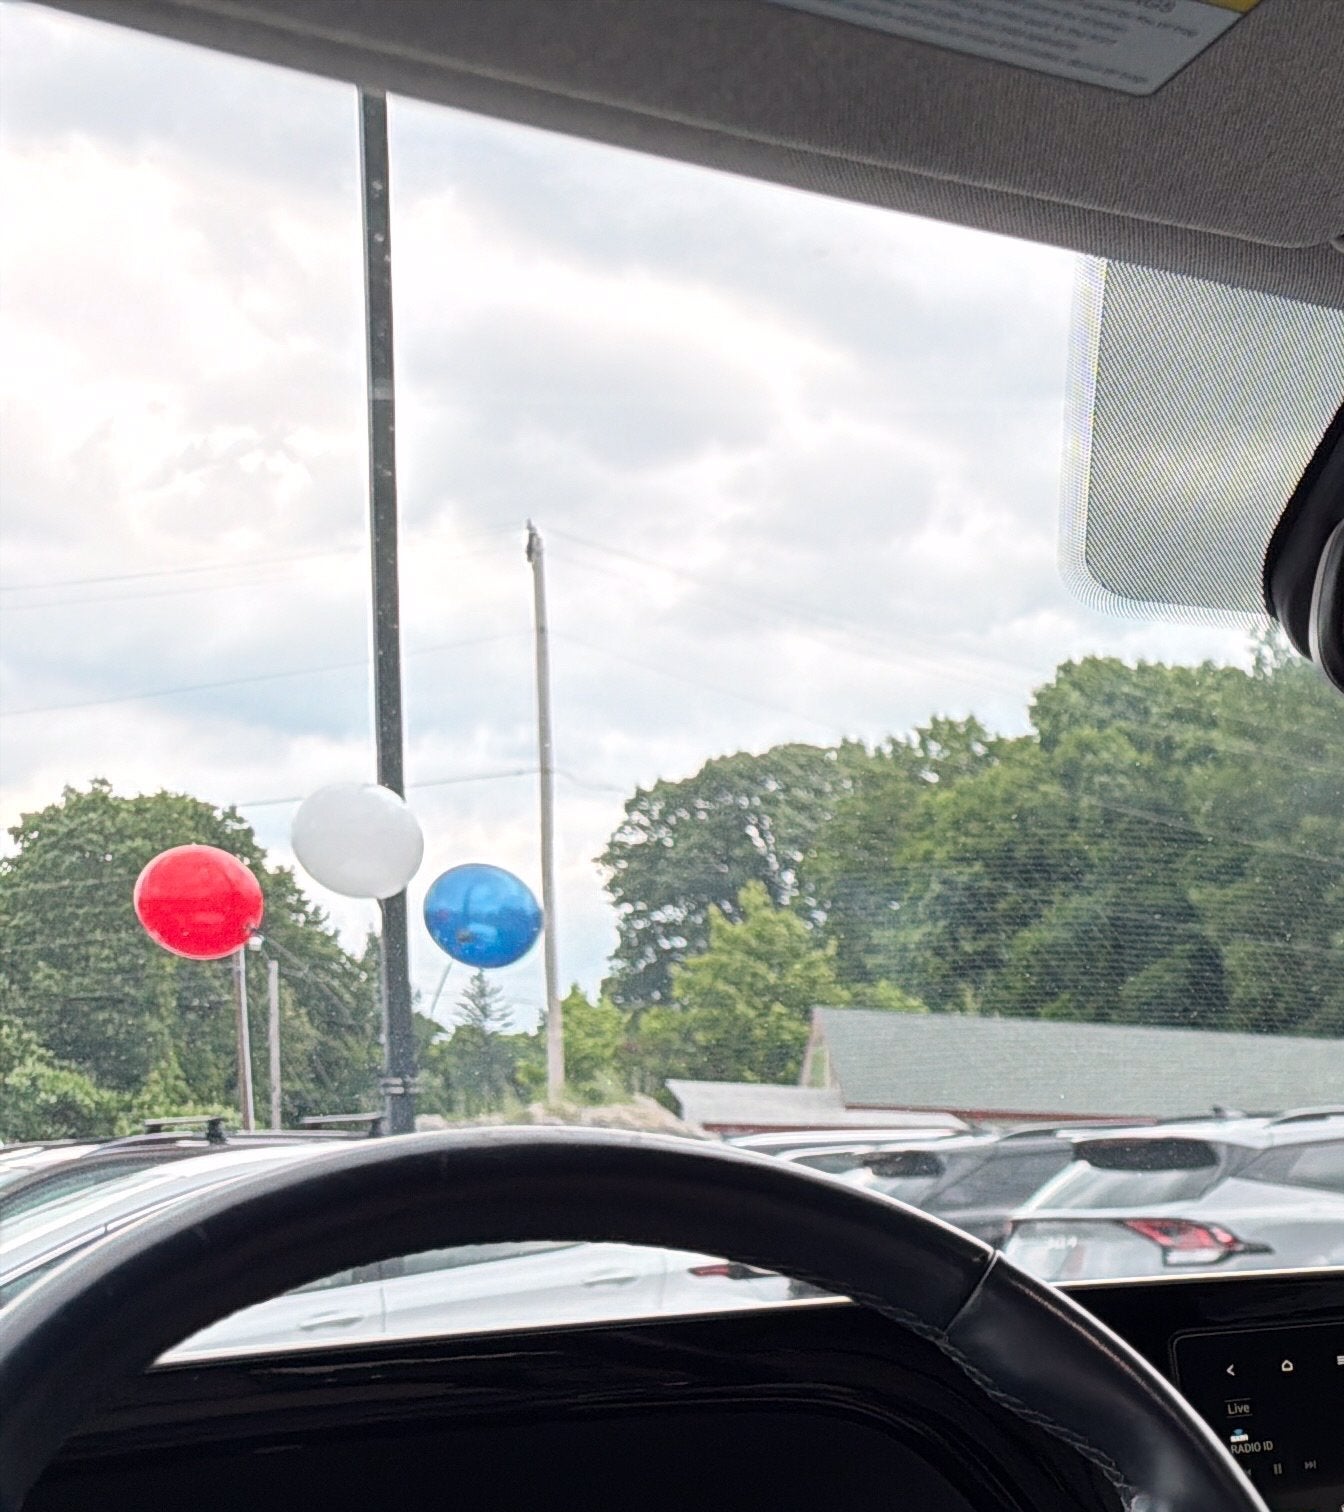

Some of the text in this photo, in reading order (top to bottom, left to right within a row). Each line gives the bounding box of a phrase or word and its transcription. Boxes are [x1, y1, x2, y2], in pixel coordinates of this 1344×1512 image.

[1227, 1403, 1250, 1415] Live
[1230, 1440, 1274, 1454] RADIO ID
